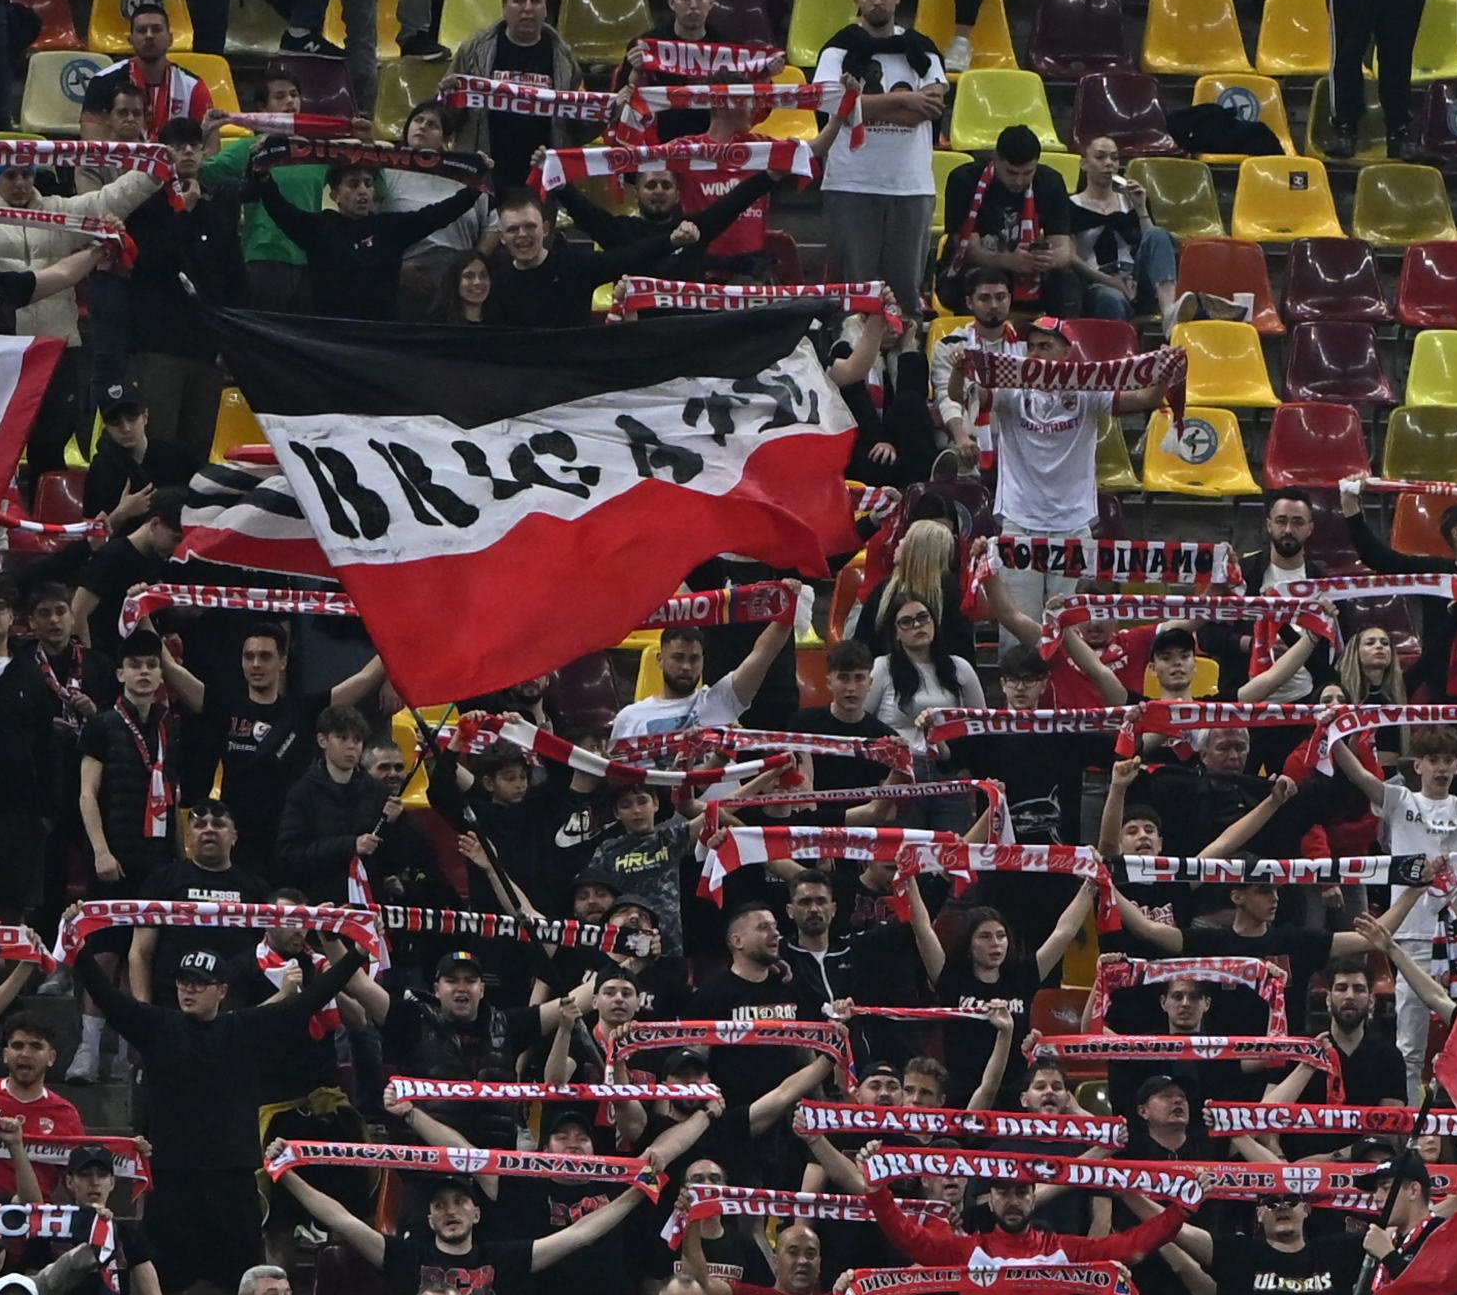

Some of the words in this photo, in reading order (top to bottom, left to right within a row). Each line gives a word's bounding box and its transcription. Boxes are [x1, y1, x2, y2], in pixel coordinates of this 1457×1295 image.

[630, 280, 730, 296] DOAR
[747, 281, 872, 298] DINAMO
[1020, 358, 1157, 390] DINAMO
[1019, 420, 1085, 437] SUPERBET
[1001, 542, 1087, 573] FORZA
[1099, 544, 1214, 576] DINAMO
[1288, 573, 1444, 596] DINAMO
[966, 716, 1125, 736] BUCURES
[1141, 855, 1377, 882] DINAMO
[187, 888, 241, 902] ELLESSE
[180, 952, 216, 971] ICON
[805, 1105, 945, 1136] BRIGATE
[1212, 1105, 1363, 1134] BRIGATE
[298, 1143, 440, 1166] BRIGATE
[495, 1152, 629, 1177] DINAMO
[866, 1152, 1021, 1186] BRIGATE
[1067, 1165, 1205, 1208] DINAMO
[858, 1266, 962, 1291] BRIGATE
[1005, 1264, 1112, 1289] DINAMO
